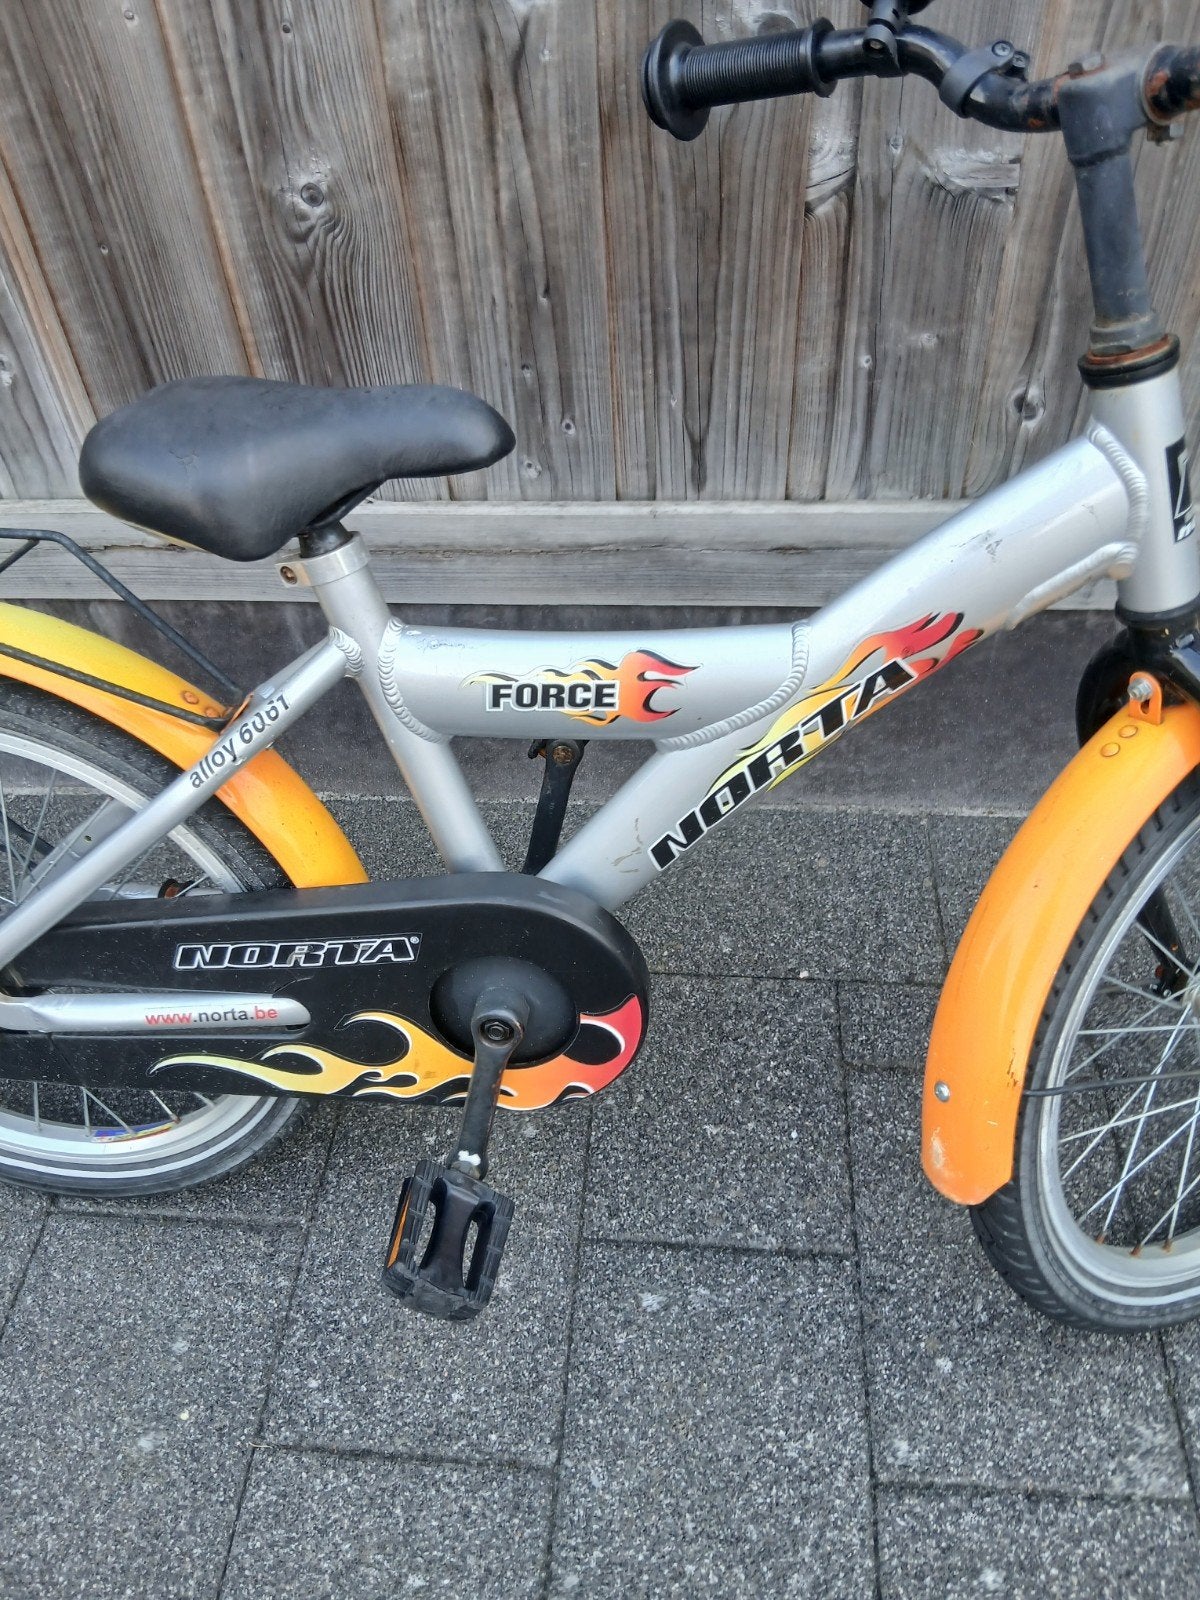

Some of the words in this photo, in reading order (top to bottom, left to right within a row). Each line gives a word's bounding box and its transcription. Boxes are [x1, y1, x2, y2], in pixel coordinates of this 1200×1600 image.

[487, 681, 619, 711] FORCE
[189, 738, 237, 789] alloy
[239, 694, 290, 744] 6061
[648, 658, 919, 871] NORTA
[145, 1006, 279, 1026] www.norta.be
